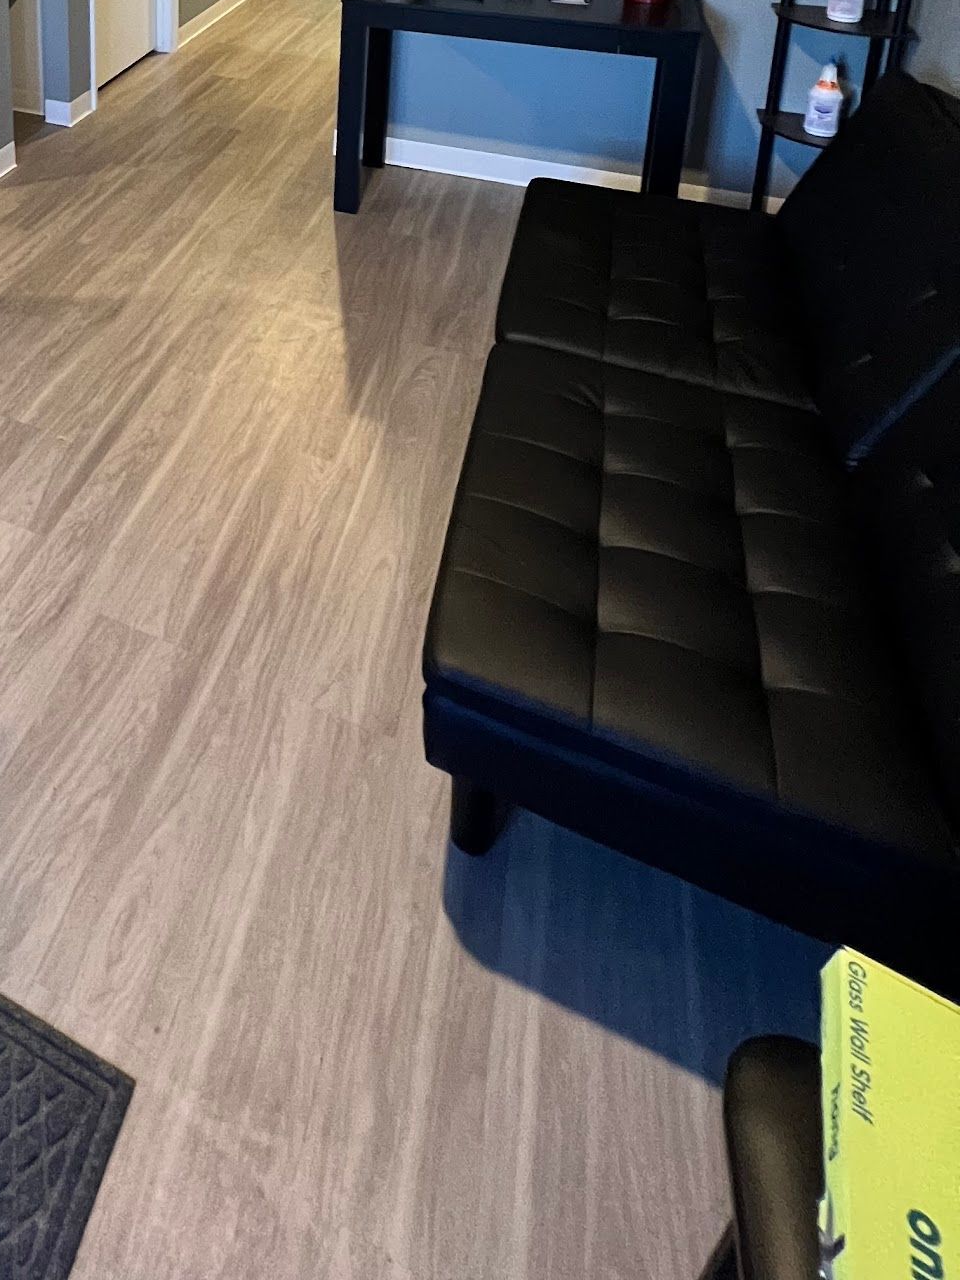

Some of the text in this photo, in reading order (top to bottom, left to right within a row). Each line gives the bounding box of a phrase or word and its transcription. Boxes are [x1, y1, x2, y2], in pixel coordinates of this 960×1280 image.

[847, 961, 874, 1126] Glass Wall Shelf
